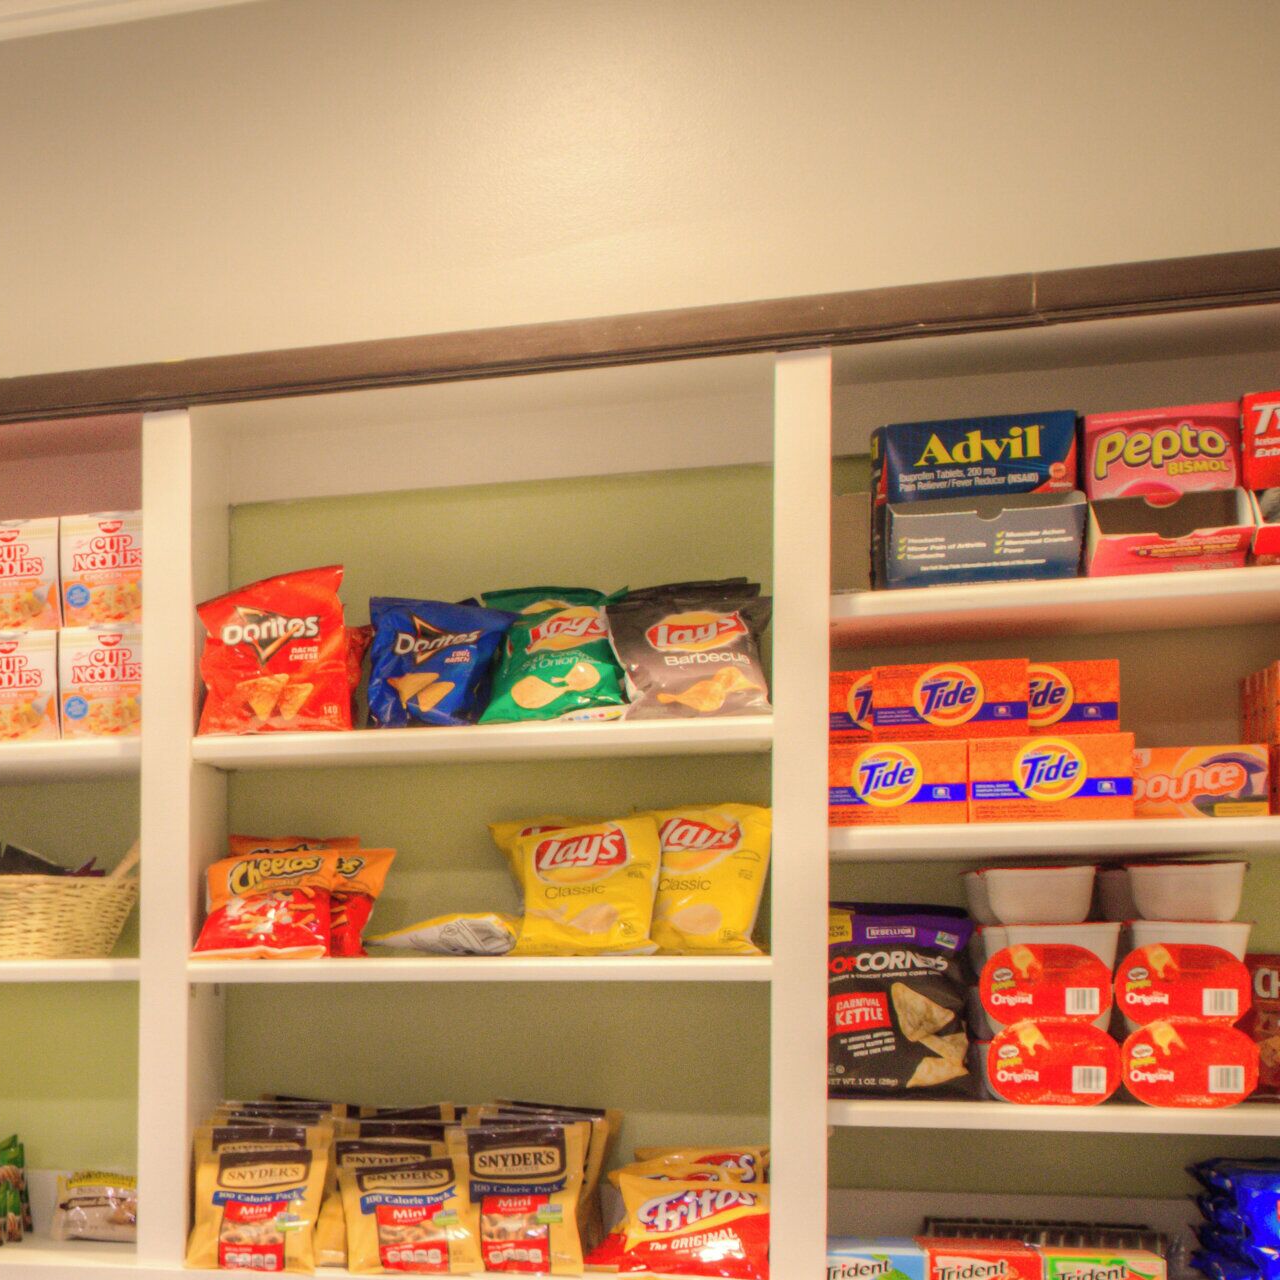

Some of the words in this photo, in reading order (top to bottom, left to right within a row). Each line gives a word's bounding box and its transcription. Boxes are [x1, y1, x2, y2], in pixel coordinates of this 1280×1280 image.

[914, 425, 1042, 466] Advil
[1095, 424, 1227, 480] Pepto
[967, 468, 982, 476] 200
[983, 468, 996, 477] mg
[1167, 460, 1230, 476] BISMOL
[899, 482, 917, 492] Pain
[974, 475, 1005, 485] Reducer
[90, 535, 133, 553] CUP
[222, 613, 320, 646] Doritos
[395, 629, 481, 655] Doritos
[89, 649, 132, 666] CUP
[289, 653, 318, 661] CHEESE
[291, 646, 318, 654] NACHO
[444, 656, 471, 664] RANCH
[540, 657, 579, 670] Onion
[665, 652, 751, 667] Barbecue
[921, 680, 977, 716] Tide
[859, 761, 915, 796] Tide
[1021, 755, 1079, 790] Tide
[540, 832, 621, 870] Lay's
[229, 856, 323, 896] Cheetos
[544, 883, 606, 900] Classic
[658, 878, 712, 893] Classic
[870, 927, 912, 936] REBELLION
[836, 997, 880, 1011] CARNIVAL
[991, 992, 1032, 1006] Original
[1125, 992, 1169, 1006] Original
[835, 1008, 884, 1026] KETTLE
[996, 1069, 1039, 1083] Original
[1130, 1069, 1174, 1083] Original
[478, 1151, 555, 1168] SNYDER'S
[228, 1167, 300, 1181] SNYDER'S
[474, 1183, 490, 1192] 100
[493, 1184, 531, 1194] Calorie
[535, 1183, 559, 1193] Pack
[218, 1191, 235, 1200] 100
[237, 1192, 273, 1203] Calorie
[276, 1190, 300, 1200] Pack
[365, 1194, 382, 1204] 100
[385, 1195, 423, 1205] Calorie
[427, 1191, 450, 1204] Pack
[498, 1195, 531, 1208] Mini
[240, 1204, 272, 1215] Mini
[393, 1208, 427, 1220] Mini
[637, 1188, 758, 1232] Fritos
[649, 1241, 667, 1252] The
[671, 1226, 738, 1250] ORIGINAL
